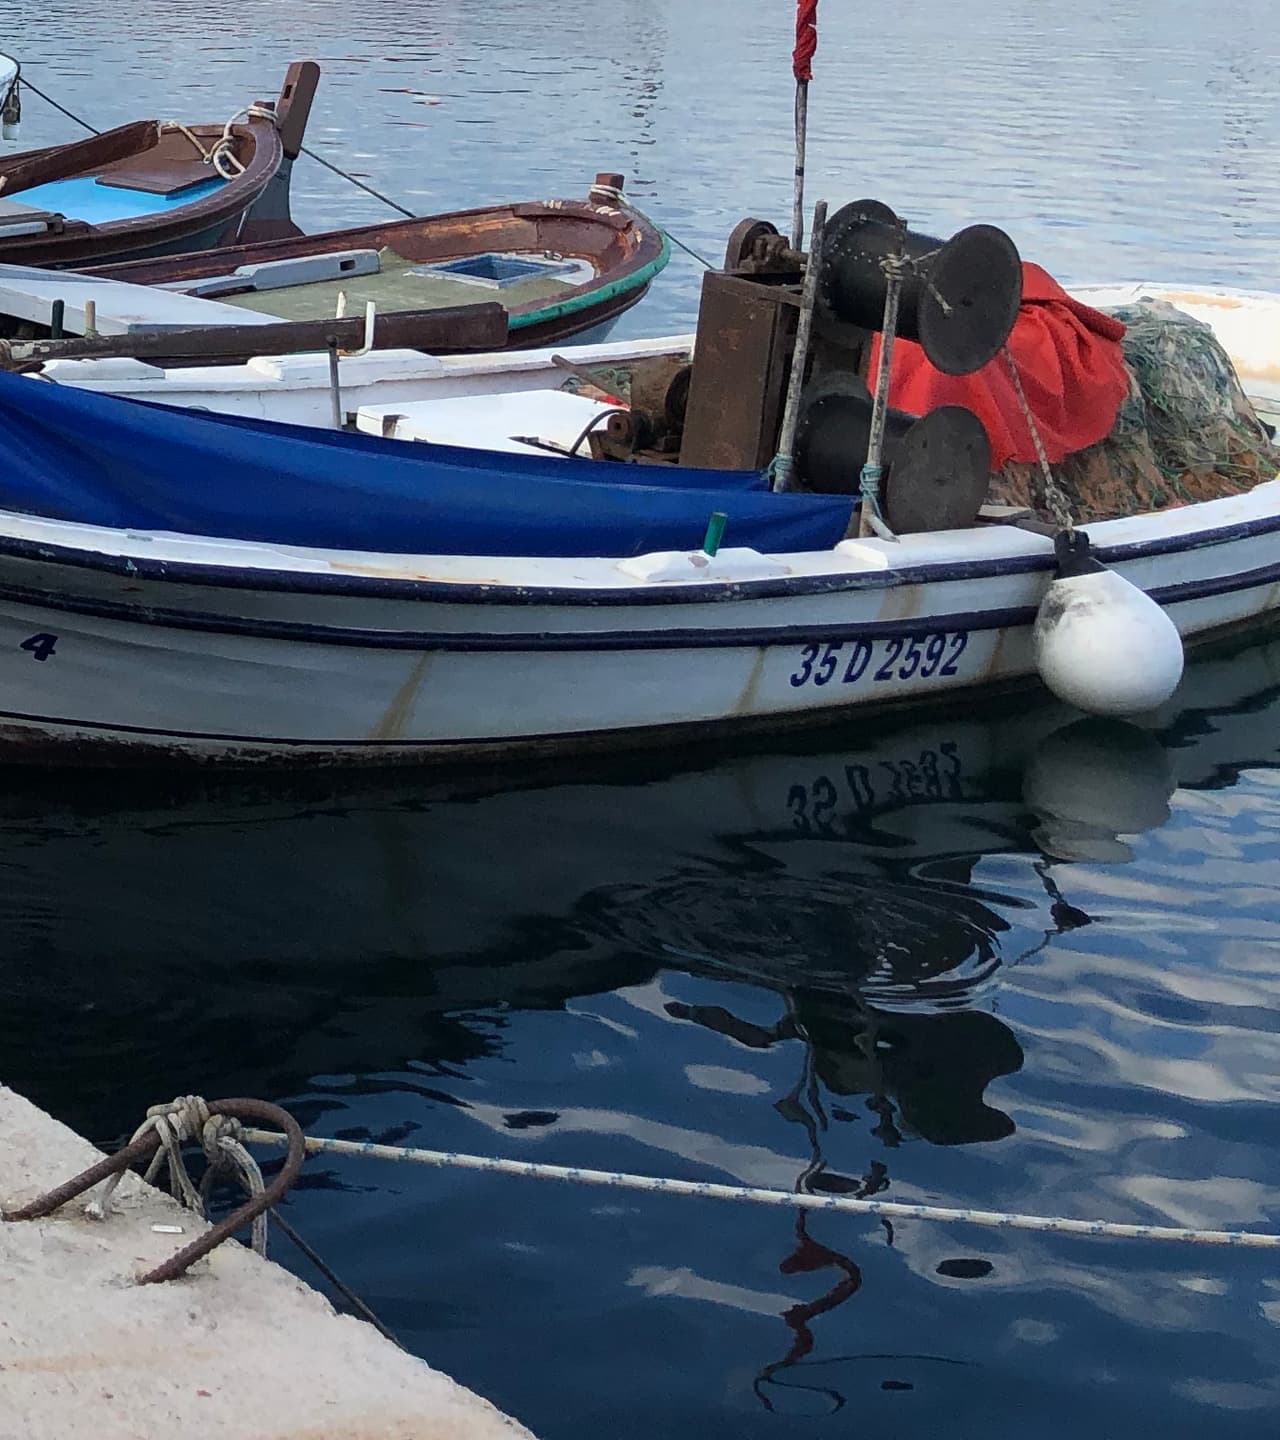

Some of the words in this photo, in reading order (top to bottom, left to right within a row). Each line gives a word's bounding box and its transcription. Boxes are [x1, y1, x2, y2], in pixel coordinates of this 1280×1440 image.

[20, 632, 59, 662] 4
[790, 641, 842, 687] 35
[842, 639, 873, 683] D
[873, 630, 968, 681] 2592
